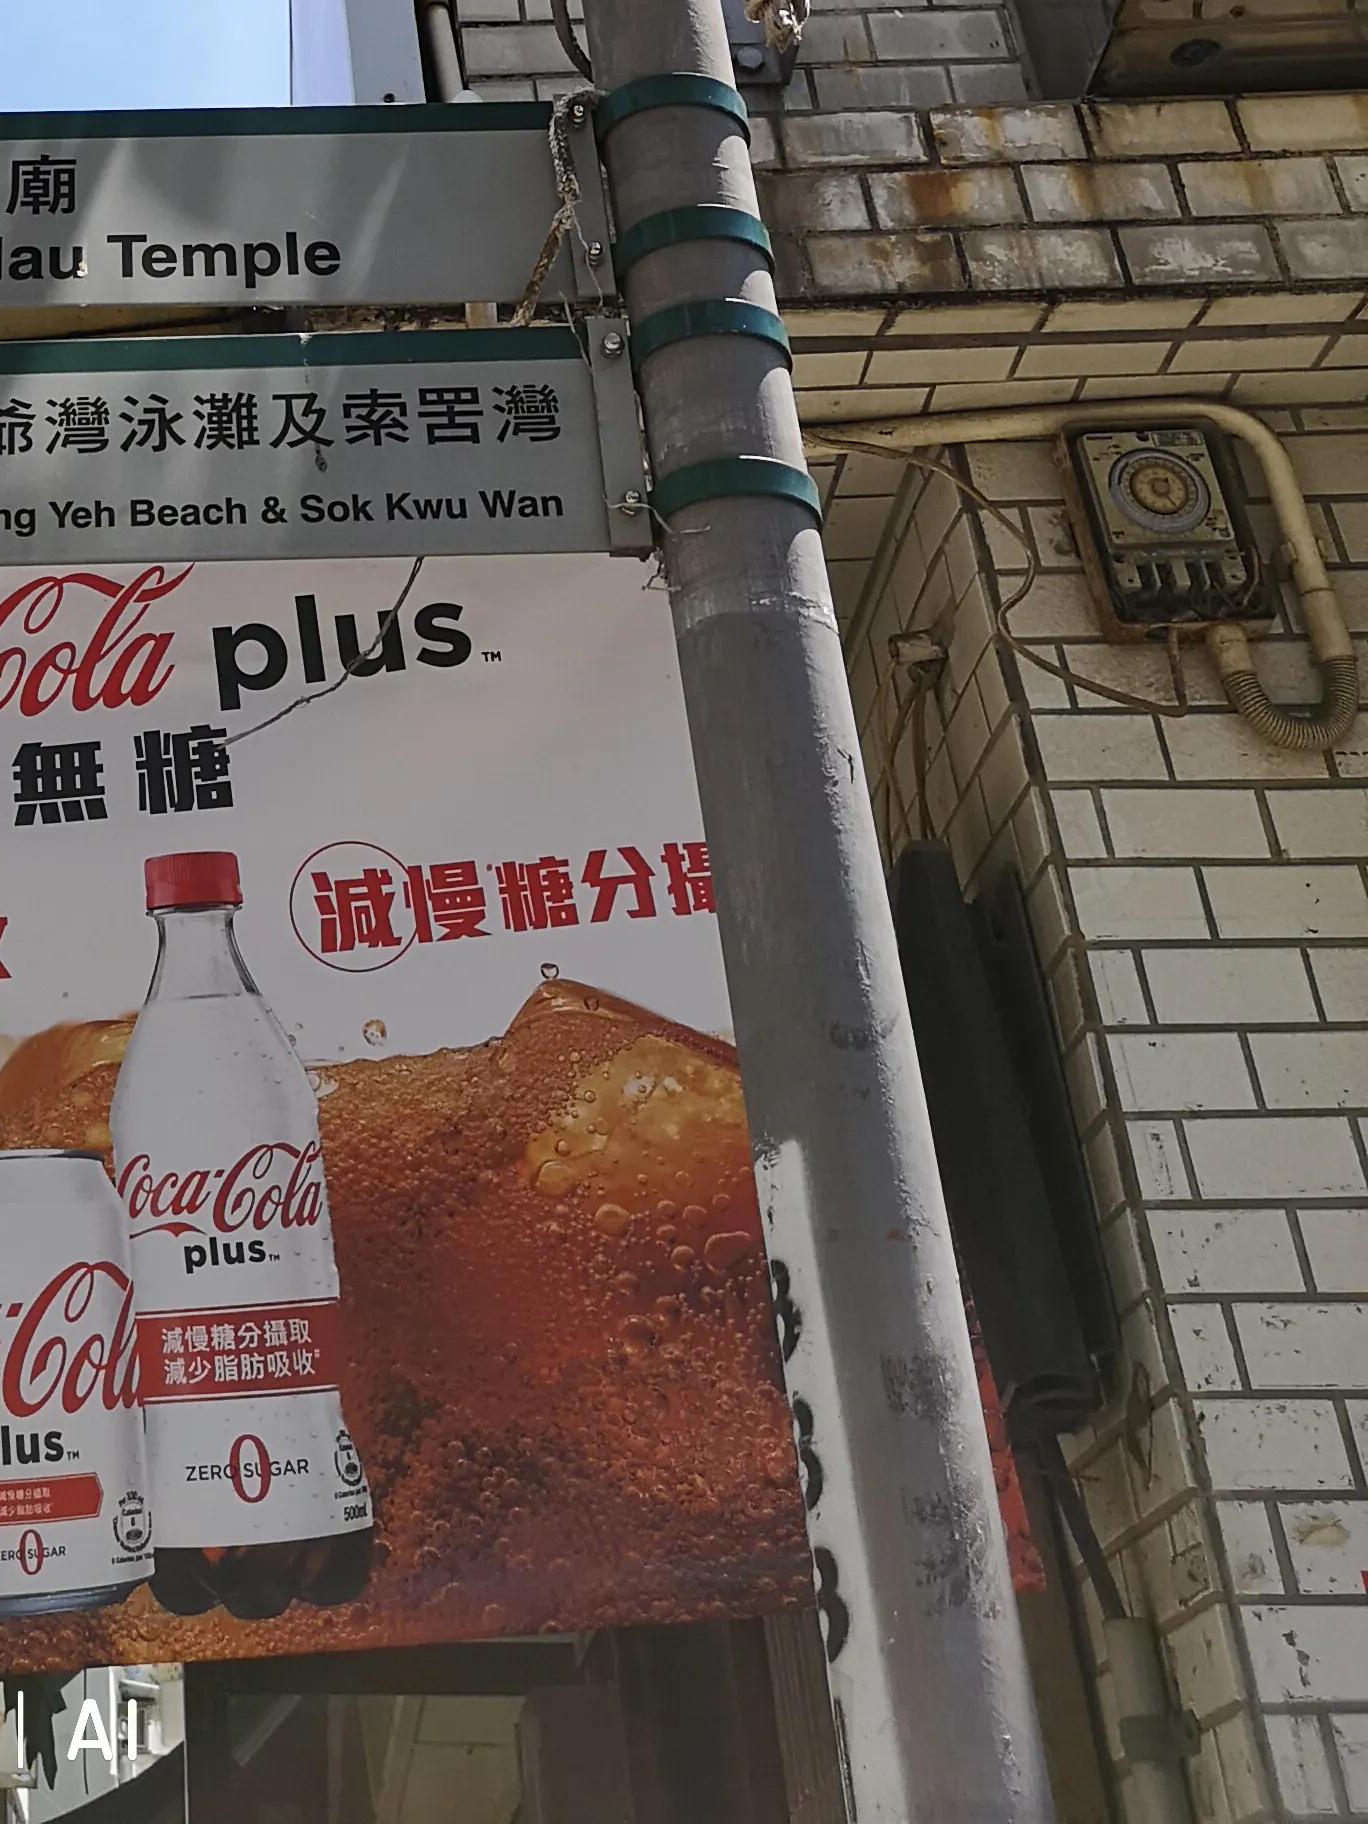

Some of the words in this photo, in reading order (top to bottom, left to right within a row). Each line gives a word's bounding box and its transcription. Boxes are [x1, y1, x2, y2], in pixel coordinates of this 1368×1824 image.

[106, 231, 341, 289] Temple
[48, 500, 116, 529] Yeh
[130, 497, 248, 527] Beach
[261, 495, 288, 524] &
[300, 492, 374, 522] Sok
[385, 492, 468, 521] Kwu
[479, 489, 564, 519] Wan
[210, 594, 472, 711] plus
[12, 725, 234, 827] 無糖
[184, 1236, 266, 1274] plus
[161, 1318, 312, 1354] 減慢糖分攝取
